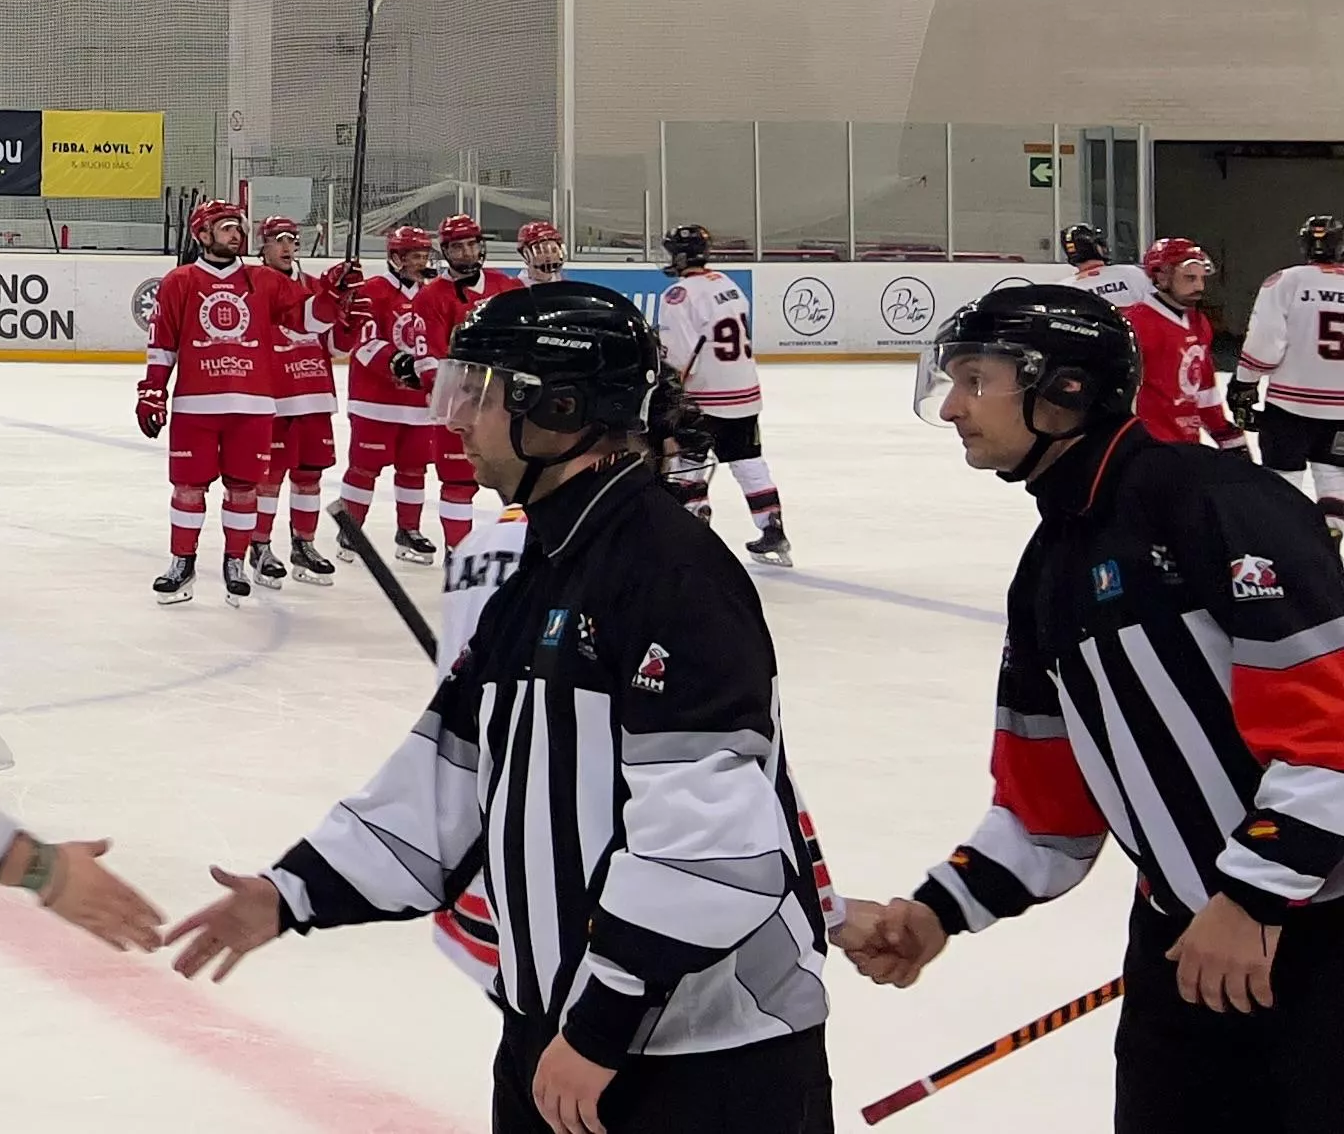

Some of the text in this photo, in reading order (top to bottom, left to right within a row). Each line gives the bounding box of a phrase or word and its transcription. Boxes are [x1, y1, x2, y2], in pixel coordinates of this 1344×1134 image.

[140, 143, 154, 155] TV
[1087, 281, 1128, 298] ARCIA
[1301, 291, 1316, 303] J.
[1050, 319, 1100, 339] BAUER
[1317, 310, 1344, 362] 5
[536, 336, 593, 351] BAUER
